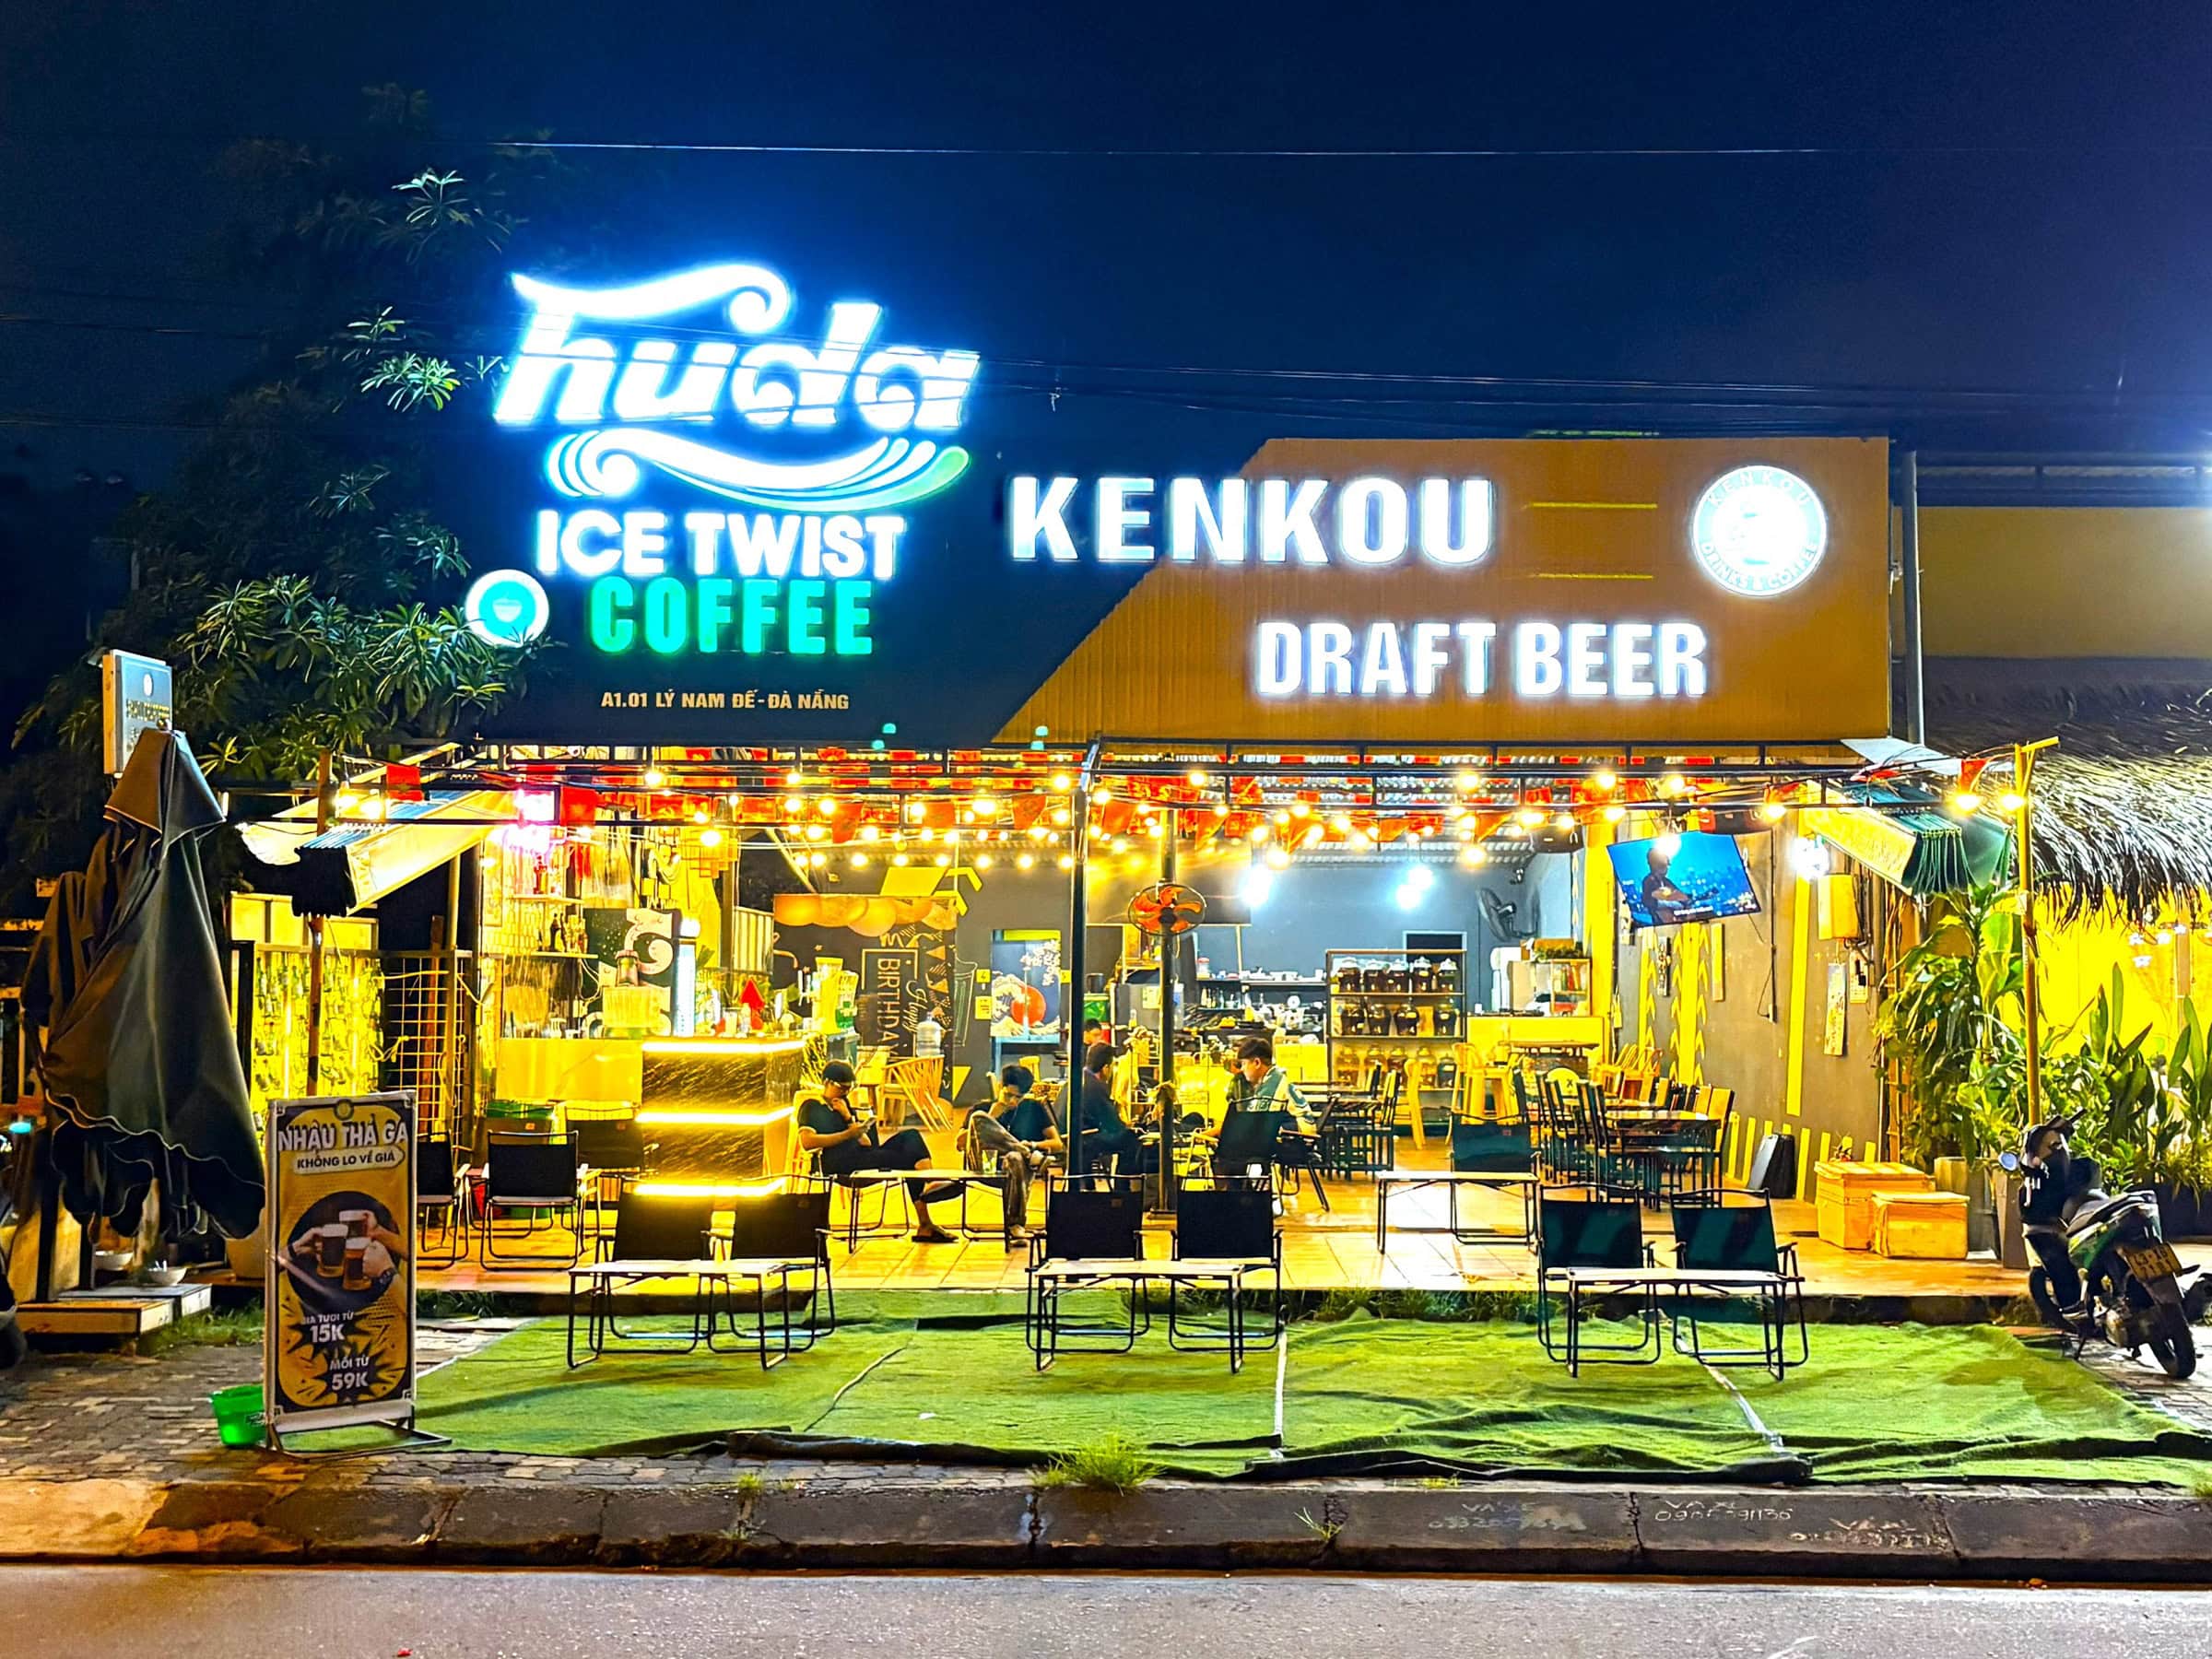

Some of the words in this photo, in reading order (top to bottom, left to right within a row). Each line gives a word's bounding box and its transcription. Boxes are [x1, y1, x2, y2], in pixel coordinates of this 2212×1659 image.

[1010, 476, 1494, 567] KENKOU
[537, 510, 665, 573] ICE
[685, 512, 905, 579] TWIST
[590, 576, 873, 654] COFFEE
[1256, 622, 1497, 698] DRAFT
[1516, 622, 1708, 699] BEER
[601, 692, 647, 708] A1.01
[655, 688, 676, 708] LÝ
[681, 693, 725, 709] NAM
[277, 1120, 335, 1152] NHẬU
[342, 1114, 378, 1147] THẢ
[382, 1121, 407, 1145] GA
[297, 1155, 340, 1170] KHÔNG
[343, 1156, 358, 1166] LO
[310, 1324, 345, 1343] 15K
[331, 1371, 369, 1391] 59K
